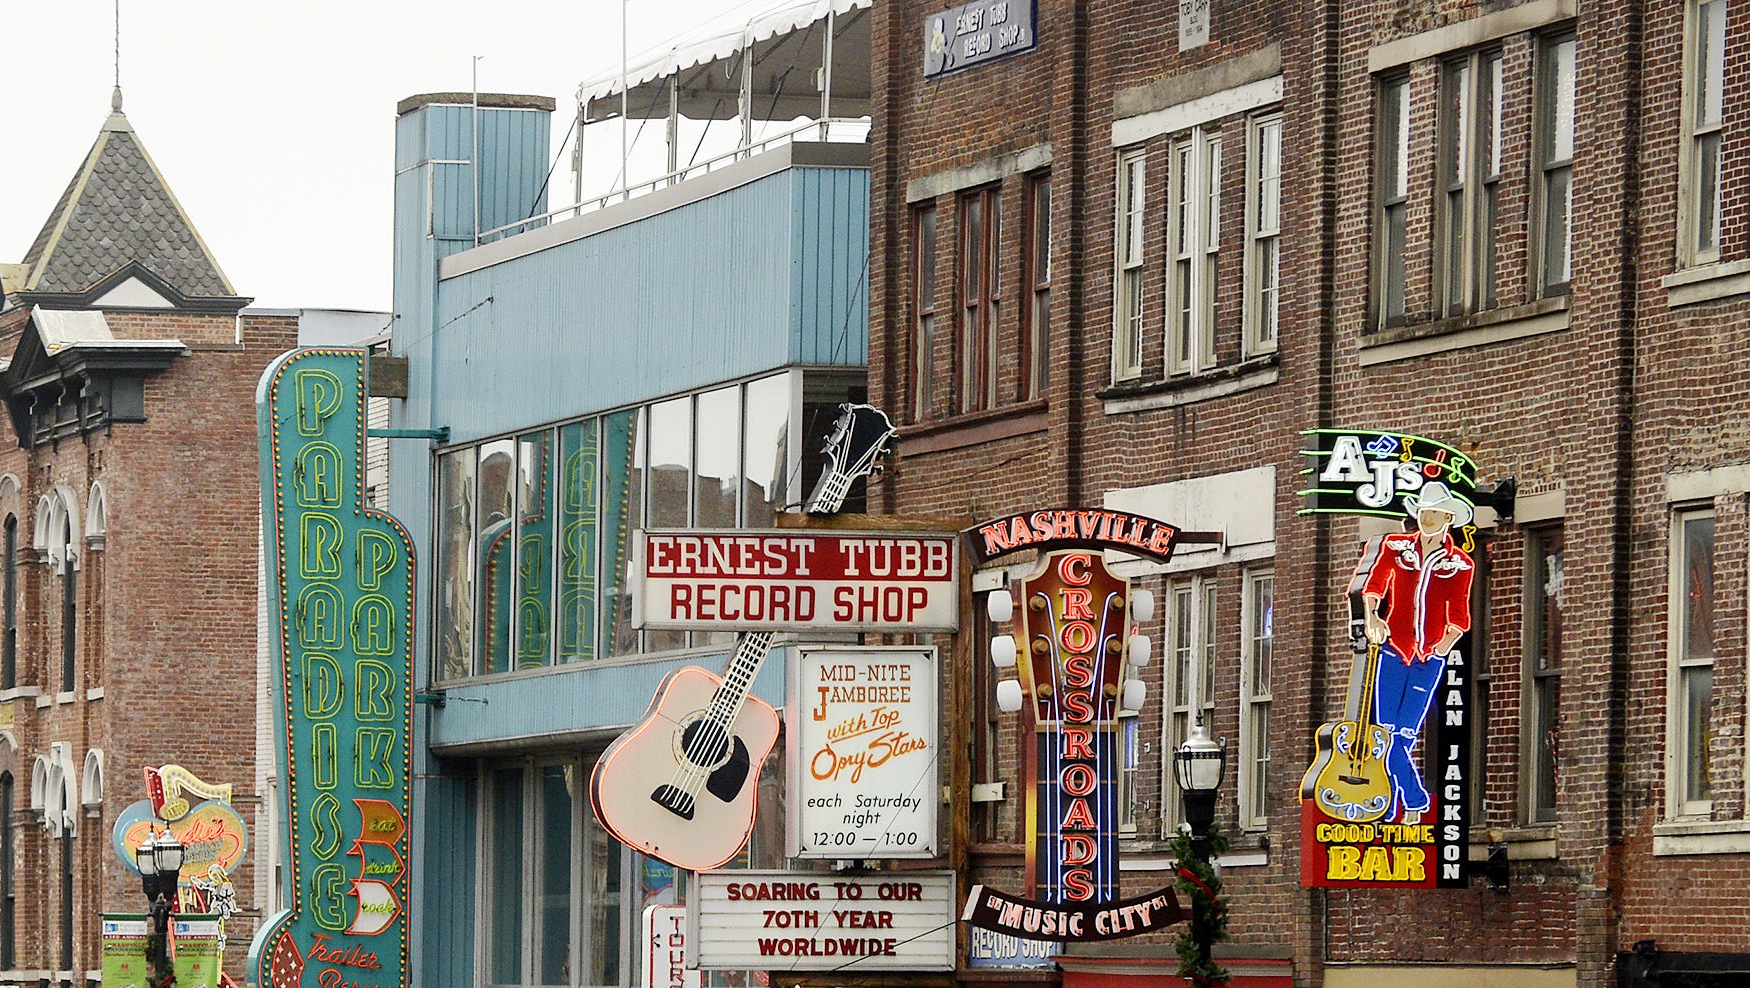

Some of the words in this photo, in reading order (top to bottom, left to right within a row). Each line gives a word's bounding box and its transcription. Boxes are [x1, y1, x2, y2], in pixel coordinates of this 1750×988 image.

[964, 33, 992, 58] RECORD
[979, 510, 1176, 556] NASHVILLE
[649, 537, 815, 576] ERNEST
[840, 540, 948, 577] TUBB
[670, 583, 815, 622] RECORD
[833, 585, 928, 623] SHOP
[294, 368, 346, 931] PARADISE
[351, 527, 396, 791] PARK
[820, 664, 911, 682] MID-NITE
[1447, 649, 1464, 726] ALAN
[813, 686, 911, 721] JAMBOREE
[827, 712, 872, 741] with
[871, 706, 901, 730] Top
[1057, 552, 1098, 901] CROSSROADS
[811, 743, 866, 784] Opry
[867, 731, 928, 769] Stars
[807, 793, 842, 808] each
[855, 793, 922, 813] Saturday
[842, 810, 882, 828] night
[1443, 744, 1463, 880] JACKSON
[368, 816, 397, 832] eat
[813, 832, 856, 846] 12:00
[885, 832, 918, 846] 1:00
[1316, 824, 1376, 843] GOOD
[1380, 823, 1435, 844] TIME
[365, 858, 400, 874] drink
[1326, 845, 1426, 882] BAR
[361, 899, 396, 913] rock
[727, 882, 820, 901] SOARING
[833, 882, 862, 901] TO
[877, 882, 923, 901] OUR
[763, 910, 819, 928] 70TH
[832, 910, 894, 928] YEAR
[307, 932, 382, 970] Trailer
[758, 938, 897, 957] WORLDWIDE
[972, 927, 1019, 959] RECORD
